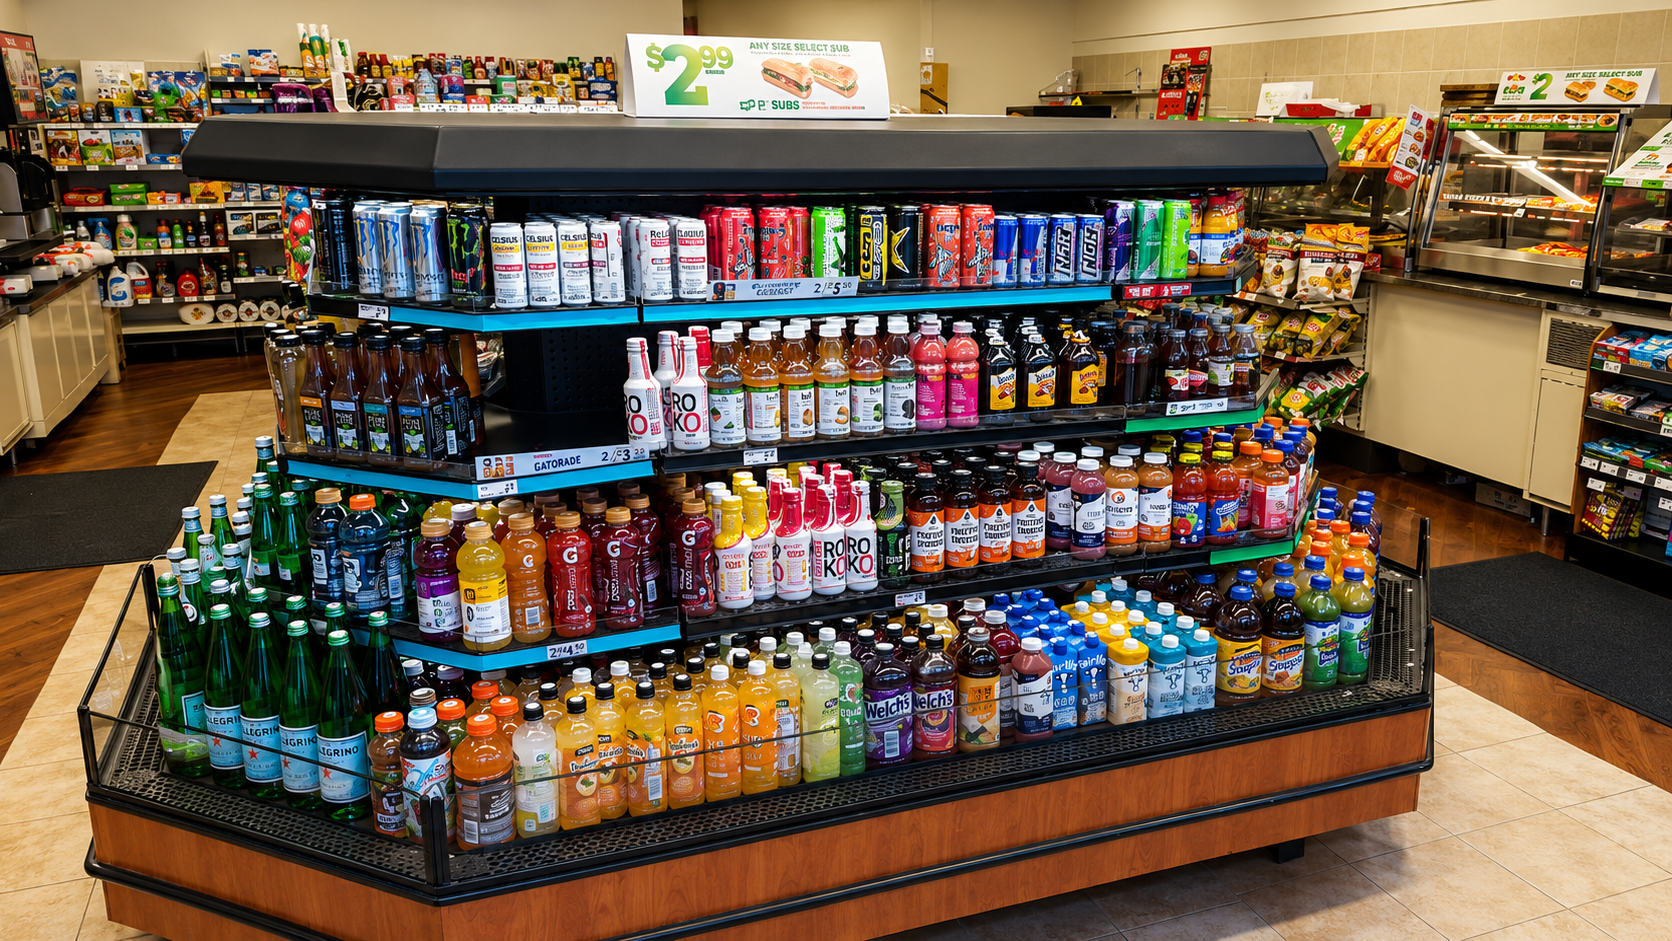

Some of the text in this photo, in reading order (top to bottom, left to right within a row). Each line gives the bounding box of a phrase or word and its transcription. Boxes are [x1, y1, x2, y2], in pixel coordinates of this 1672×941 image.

[749, 42, 850, 53] ANY SIZE SELECT SUB
[771, 100, 800, 110] SUBS
[672, 392, 696, 412] RO
[673, 412, 701, 433] KO
[534, 455, 581, 472] GATORADE
[682, 530, 696, 546] G
[846, 537, 870, 555] RO
[562, 546, 578, 564] G
[606, 540, 621, 557] G
[522, 554, 533, 567] G
[846, 554, 874, 575] KO
[864, 694, 910, 719] Welch's
